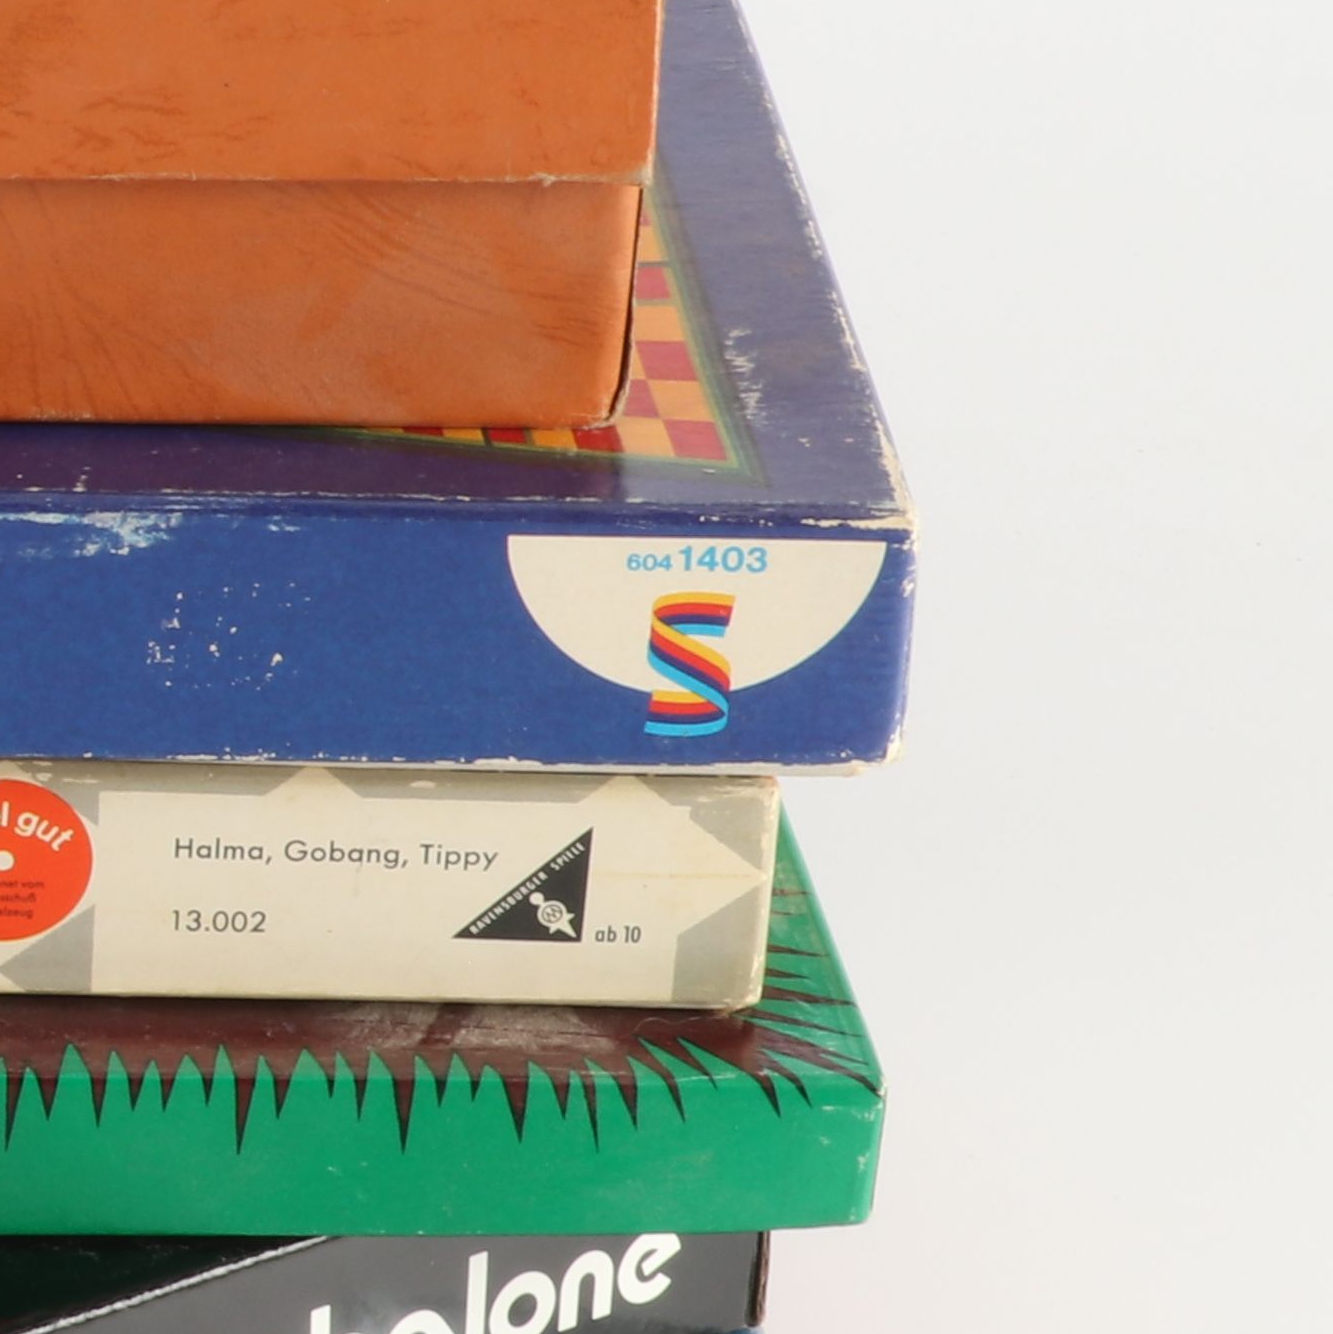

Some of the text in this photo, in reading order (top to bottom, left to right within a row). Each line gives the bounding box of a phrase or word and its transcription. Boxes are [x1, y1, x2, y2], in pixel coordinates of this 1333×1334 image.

[14, 811, 75, 852] gut
[174, 837, 499, 872] Halma, Gobang, Tippy
[171, 909, 267, 933] 13.002
[595, 925, 642, 944] ab 10
